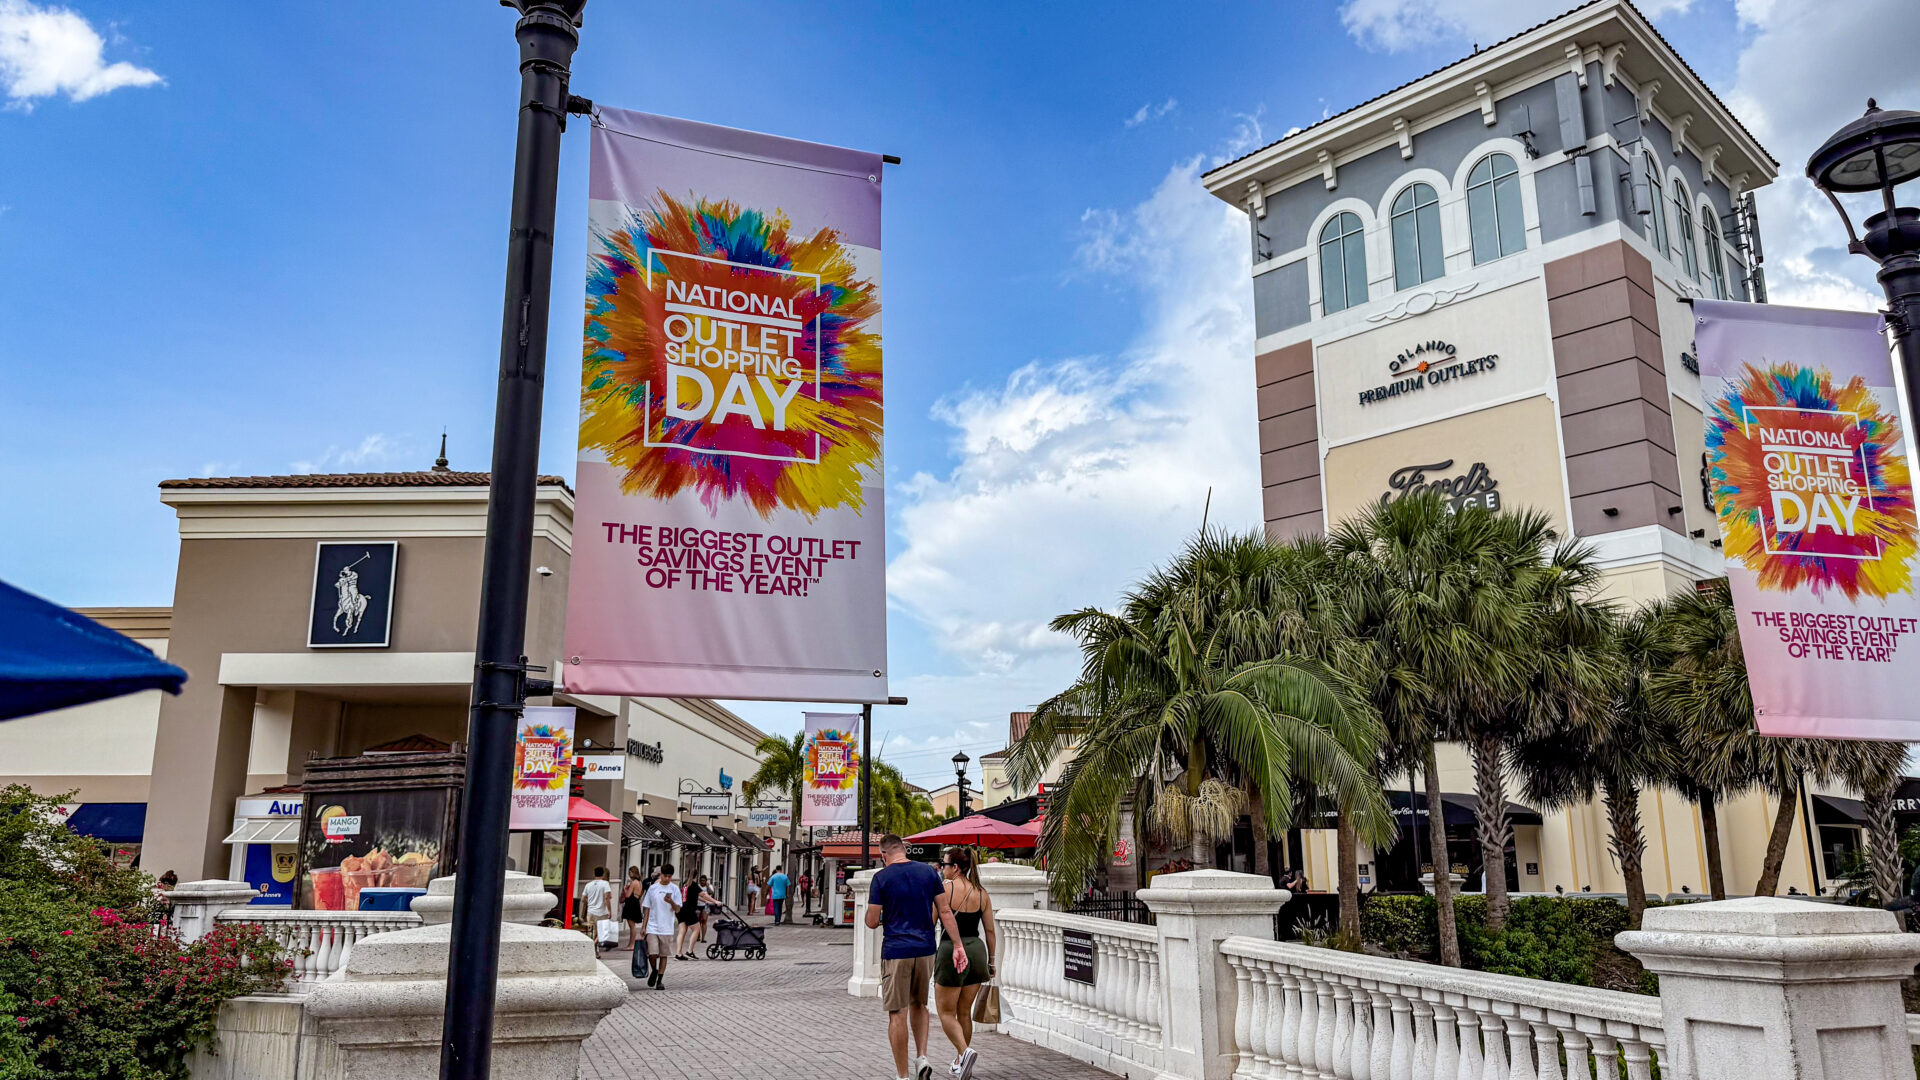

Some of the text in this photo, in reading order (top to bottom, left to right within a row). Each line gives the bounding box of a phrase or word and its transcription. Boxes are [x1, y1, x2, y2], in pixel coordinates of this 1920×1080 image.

[666, 279, 802, 320] NATIONAL
[663, 314, 802, 357] OUTLET
[664, 340, 802, 379] SHOPPING
[1389, 340, 1456, 372] ORLANDO
[666, 363, 804, 431] DAY
[1358, 374, 1425, 405] PREMIUM
[1759, 427, 1852, 448] NATIONAL
[1763, 452, 1854, 478] OUTLET
[1767, 474, 1859, 495] SHOPPING
[1770, 490, 1861, 536] DAY
[601, 522, 861, 560] THE BIGGEST OUTLET
[637, 545, 828, 578] SAVINGS EVENT
[645, 567, 682, 589] OF
[686, 569, 734, 593] THE
[1751, 611, 1917, 634] THE BIGGEST OUTLET
[1779, 627, 1899, 648] SAVINGS EVENT
[1788, 642, 1811, 658] OF
[1812, 643, 1844, 660] THE
[525, 749, 555, 758] OUTLET
[818, 752, 844, 760] OUTLET
[524, 760, 554, 774] DAY
[818, 762, 844, 775] DAY
[692, 802, 728, 810] francesca's
[749, 812, 778, 821] luggage
[330, 817, 359, 826] MANGO
